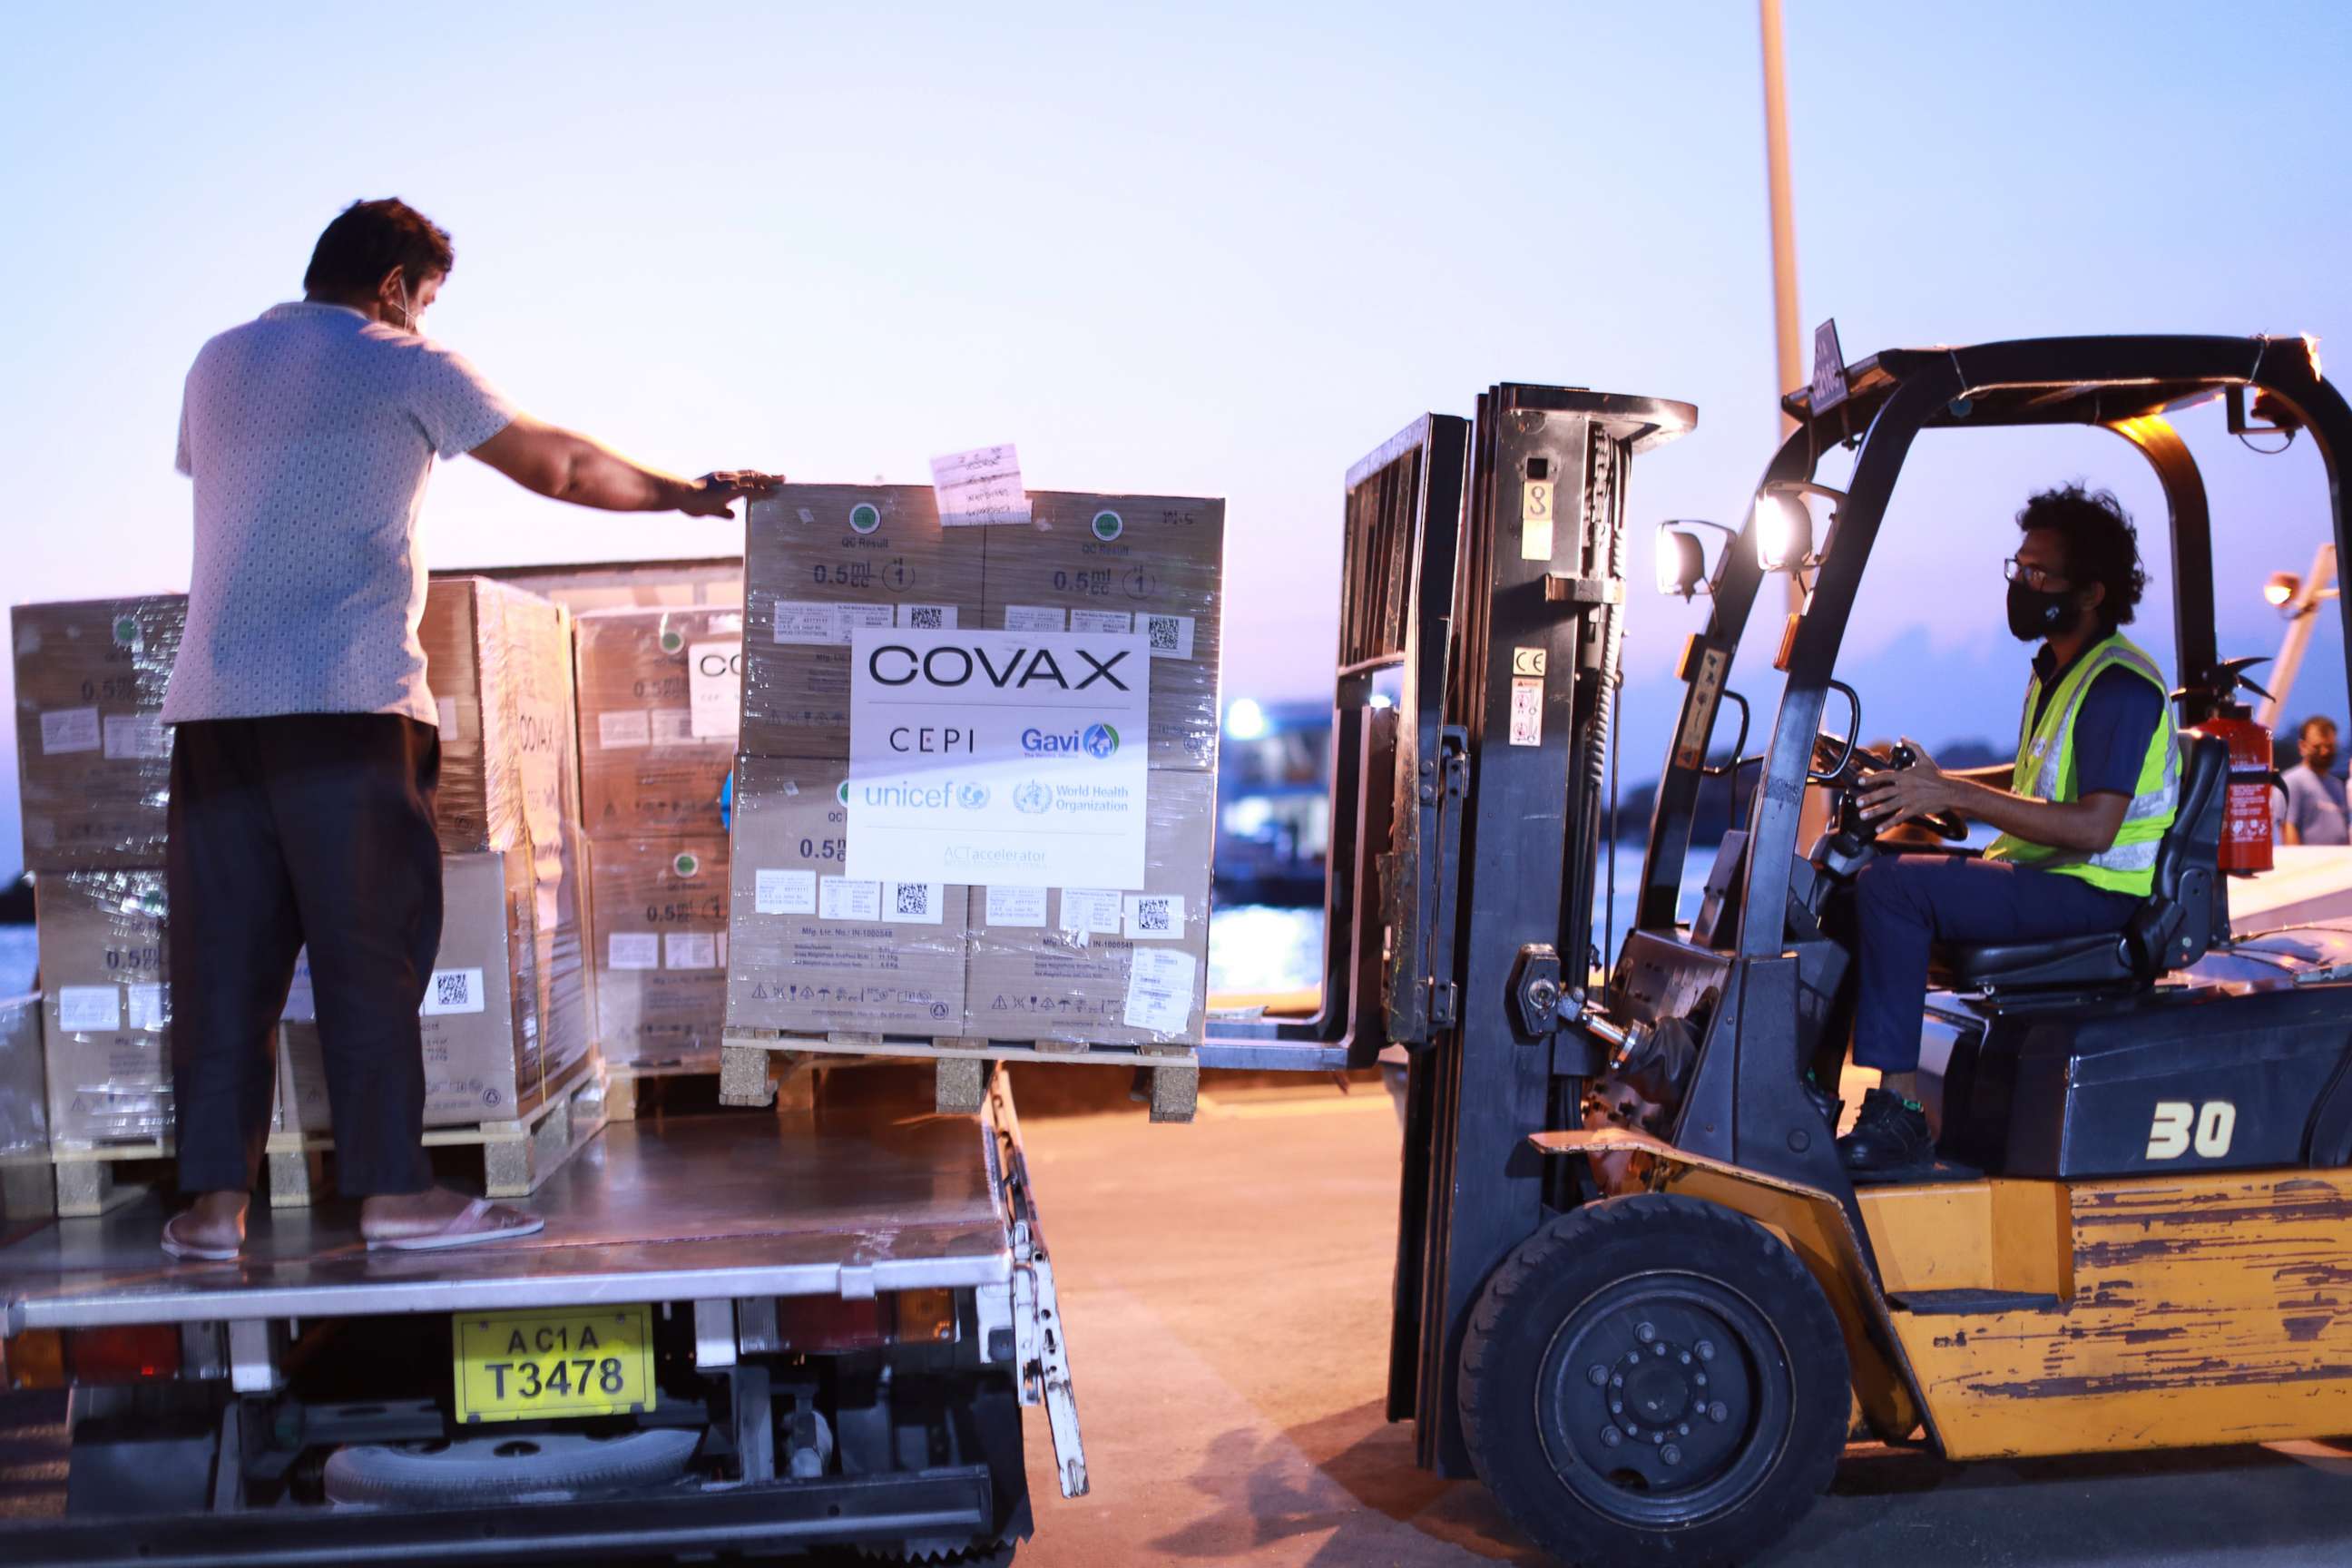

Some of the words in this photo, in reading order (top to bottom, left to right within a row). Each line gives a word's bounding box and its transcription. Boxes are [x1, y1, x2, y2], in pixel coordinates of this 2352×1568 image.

[814, 564, 848, 584] 0.5
[850, 560, 871, 576] ml
[1054, 571, 1088, 591] 0.5
[1091, 568, 1111, 582] ml
[868, 645, 1132, 691] COVAX
[889, 727, 974, 753] CEPI
[1022, 728, 1079, 753] Gavi
[865, 780, 954, 808] unicef
[1055, 784, 1089, 797] World
[1092, 785, 1129, 798] Health
[828, 812, 843, 822] QC
[1055, 799, 1129, 813] Organization
[799, 838, 835, 858] 0.5
[647, 904, 676, 922] 0.5
[106, 948, 141, 970] 0.5
[2145, 1101, 2237, 1160] 30
[485, 1357, 624, 1401] T3478
